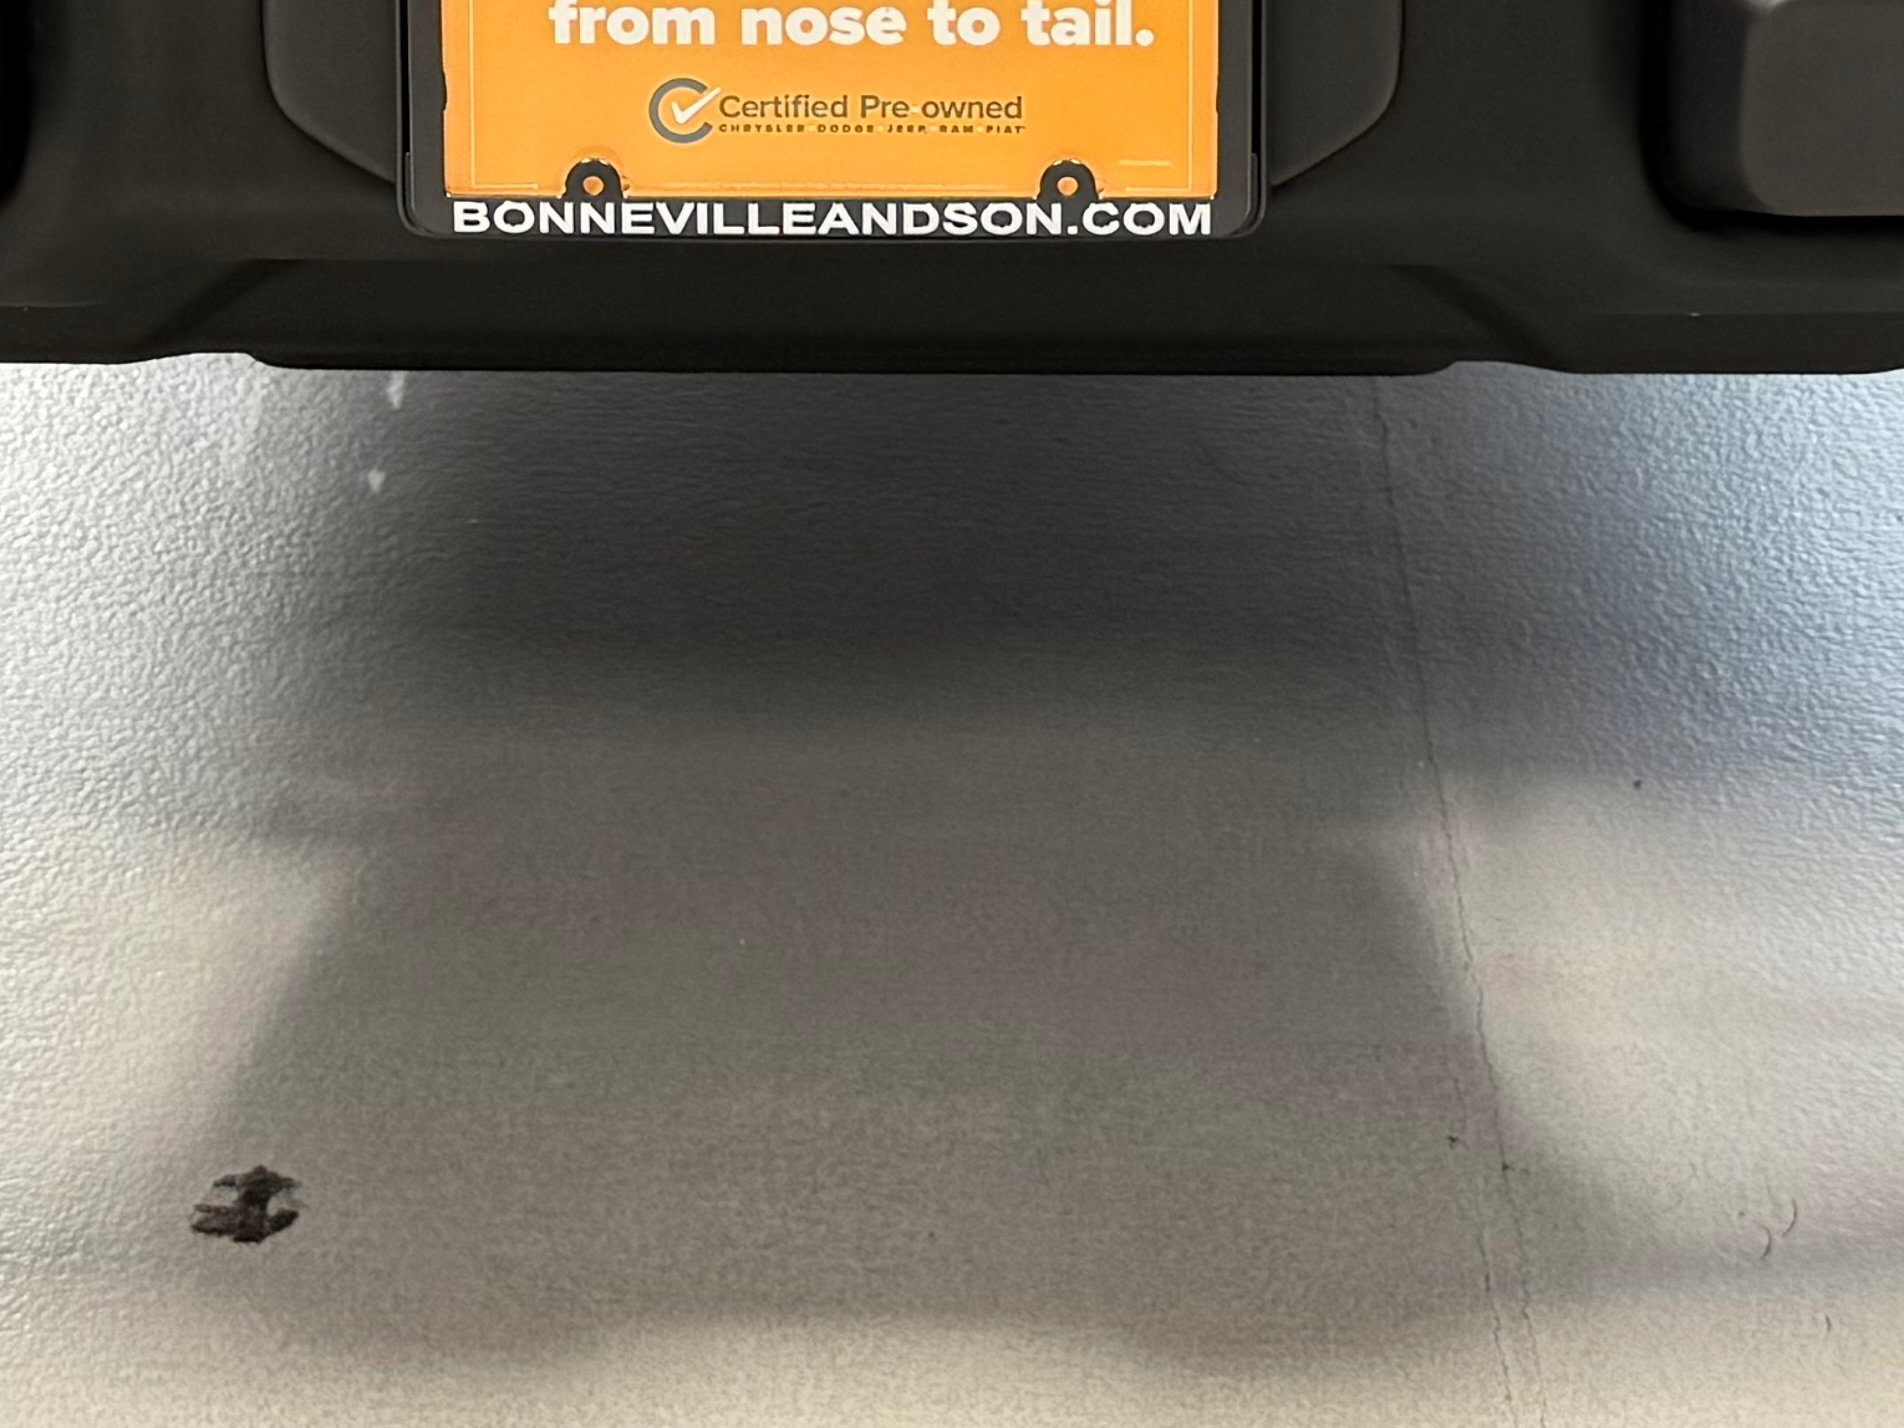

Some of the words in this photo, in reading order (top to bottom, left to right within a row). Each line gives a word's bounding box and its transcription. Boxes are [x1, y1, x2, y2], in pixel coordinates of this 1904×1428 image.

[740, 4, 904, 47] nose
[718, 94, 849, 119] Certified
[452, 199, 1214, 237] BONNEVILLEANDSON.COM
